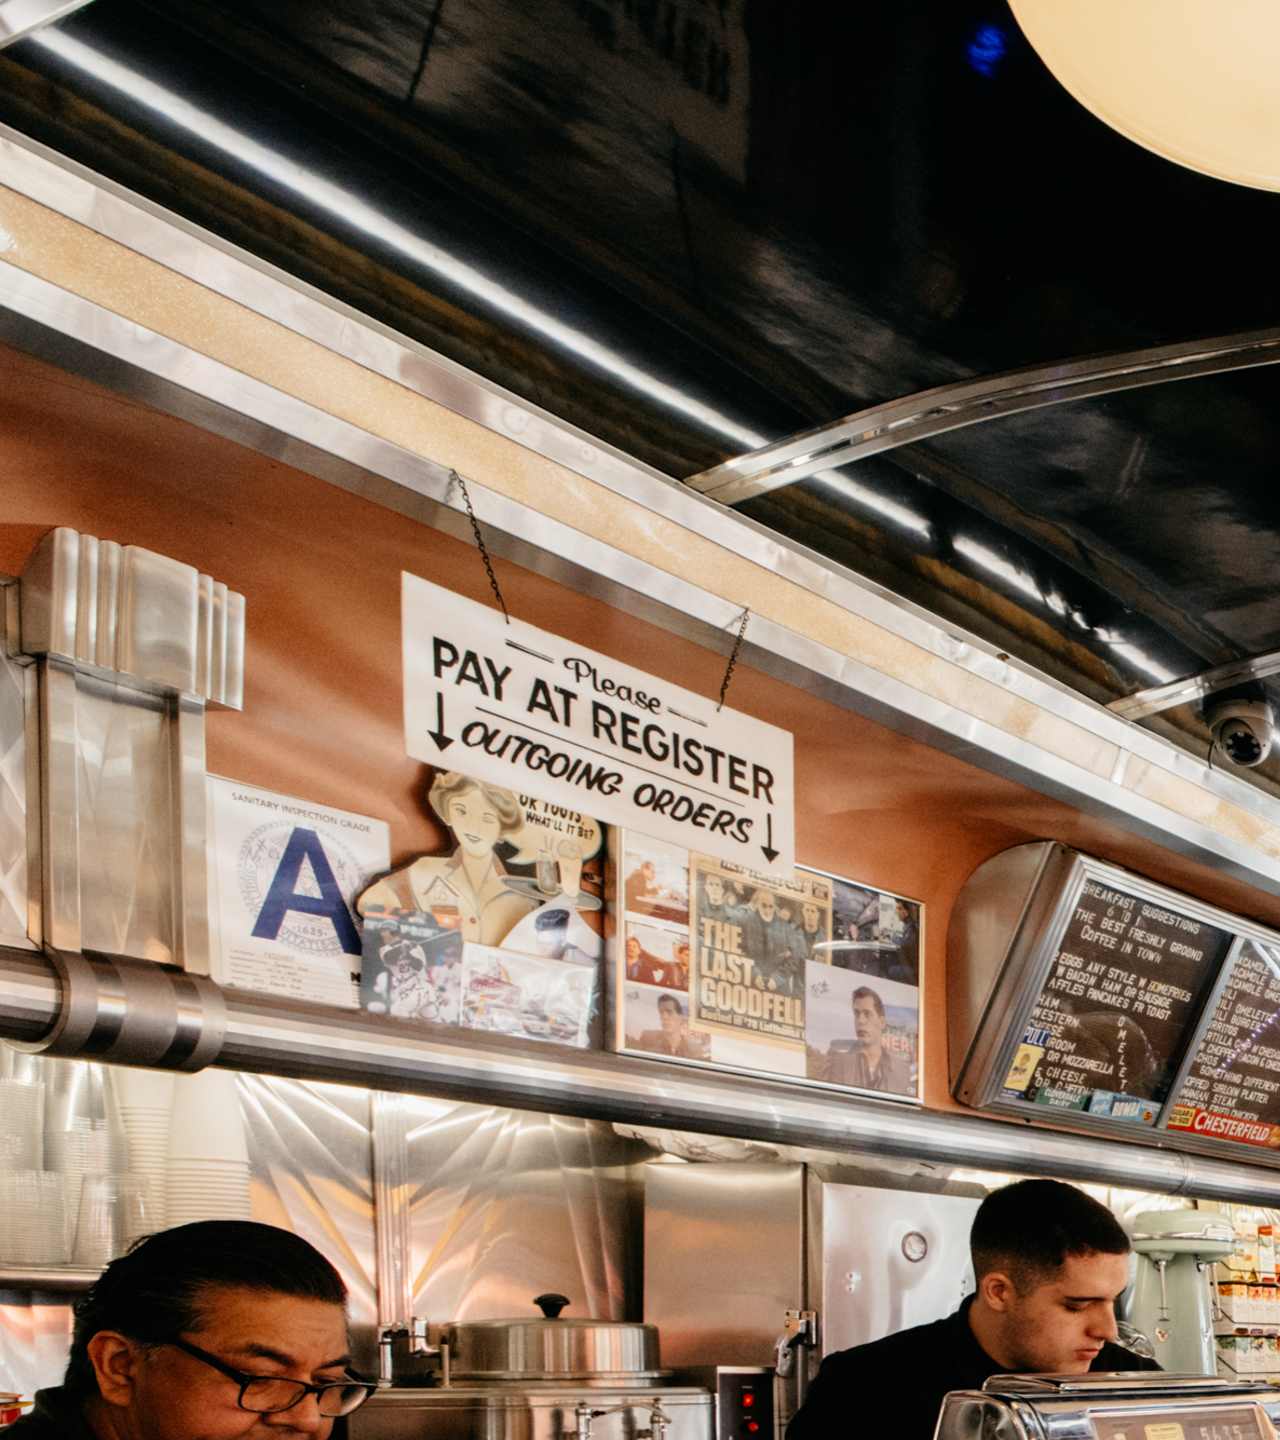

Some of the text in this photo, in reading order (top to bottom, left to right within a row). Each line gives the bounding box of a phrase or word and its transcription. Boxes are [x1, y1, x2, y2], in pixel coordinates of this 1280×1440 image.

[563, 657, 662, 713] Please
[433, 636, 774, 804] PAY AT REGISTER
[460, 721, 754, 844] OUTGOING ORDERS
[231, 791, 372, 834] SANITARY INSPECTION GRADE
[251, 826, 362, 956] A
[1082, 882, 1200, 934] BREAKFAST SUGGESTIONS
[702, 917, 743, 954] THE
[1075, 909, 1202, 960] THE BEST FRESHLY GROUND
[1121, 942, 1132, 953] IN
[1137, 947, 1162, 963] TOWN
[702, 948, 755, 986] LAST
[1059, 954, 1082, 968] EGGS
[1086, 962, 1104, 974] ANY
[1107, 968, 1135, 984] STYLE
[702, 977, 805, 1027] GOODFELL
[1036, 995, 1060, 1008] HAM
[1048, 977, 1085, 994] AFFLES
[1086, 988, 1130, 1007] PANCAKES
[1146, 1006, 1171, 1020] TOAST
[1066, 969, 1096, 984] BACON
[1101, 980, 1121, 992] HAM
[1124, 986, 1137, 997] OR
[1136, 991, 1172, 1008] SAUSAGE
[1031, 1007, 1080, 1026] WESTERN
[1046, 1067, 1087, 1082] CHEESE
[1060, 1055, 1113, 1073] MOZZARELLA
[1194, 1111, 1271, 1141] CHESTERFIELD
